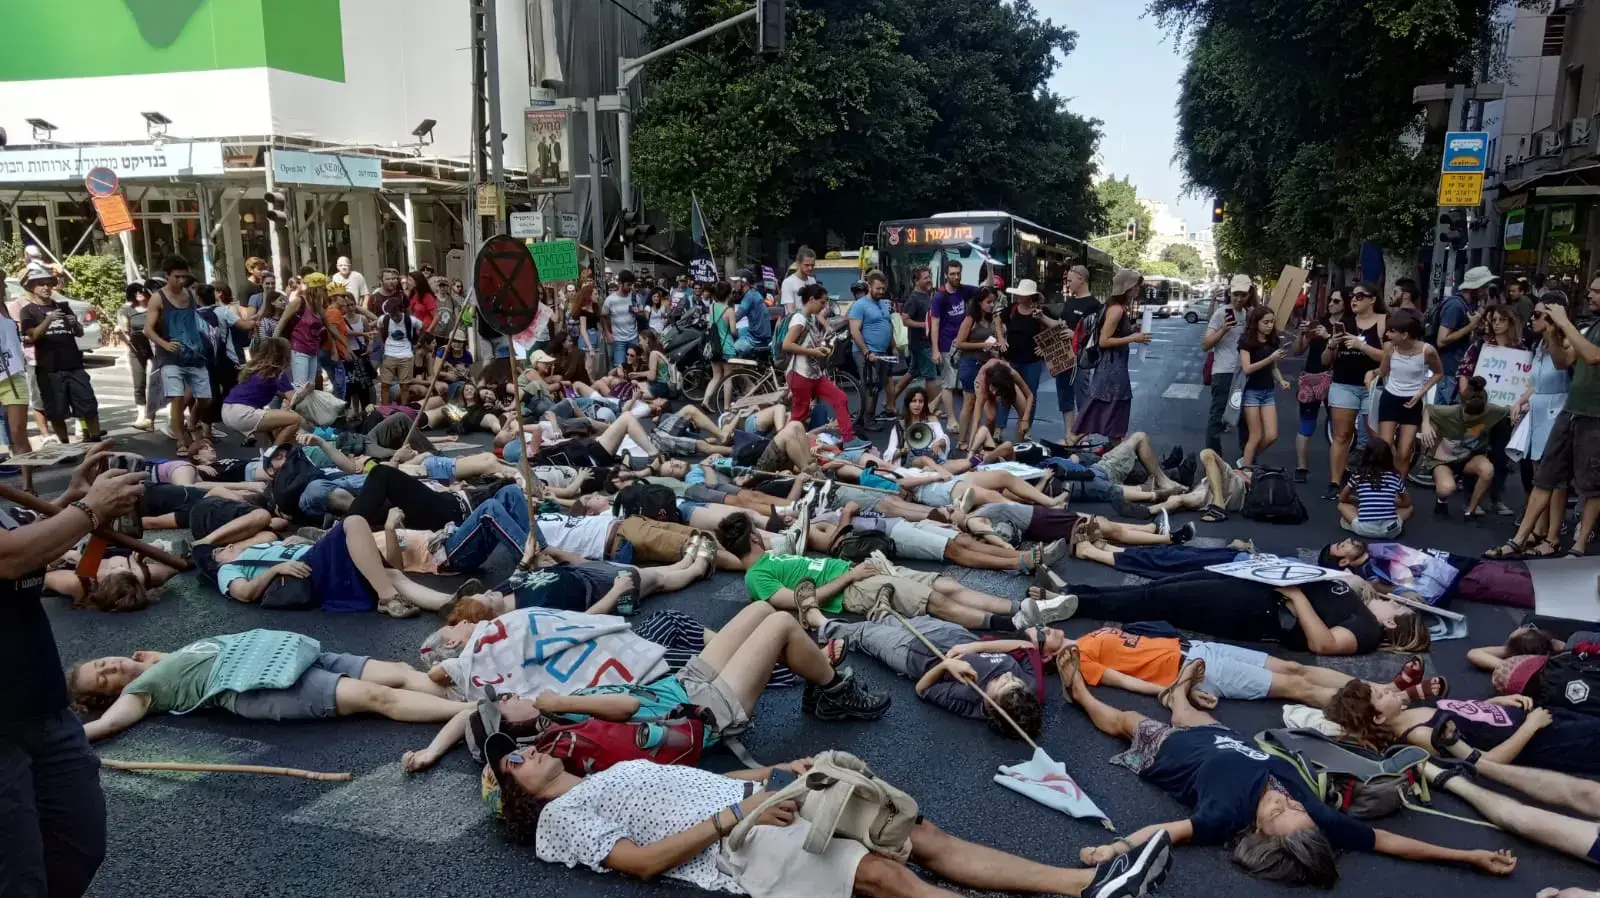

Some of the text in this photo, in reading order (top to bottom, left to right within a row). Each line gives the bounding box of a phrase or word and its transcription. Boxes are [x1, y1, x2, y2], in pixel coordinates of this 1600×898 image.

[28, 159, 71, 173] ארוחות
[121, 155, 167, 171] בנדיקט
[907, 228, 916, 243] 31
[954, 226, 973, 239] בית
[1487, 390, 1517, 402] האק
